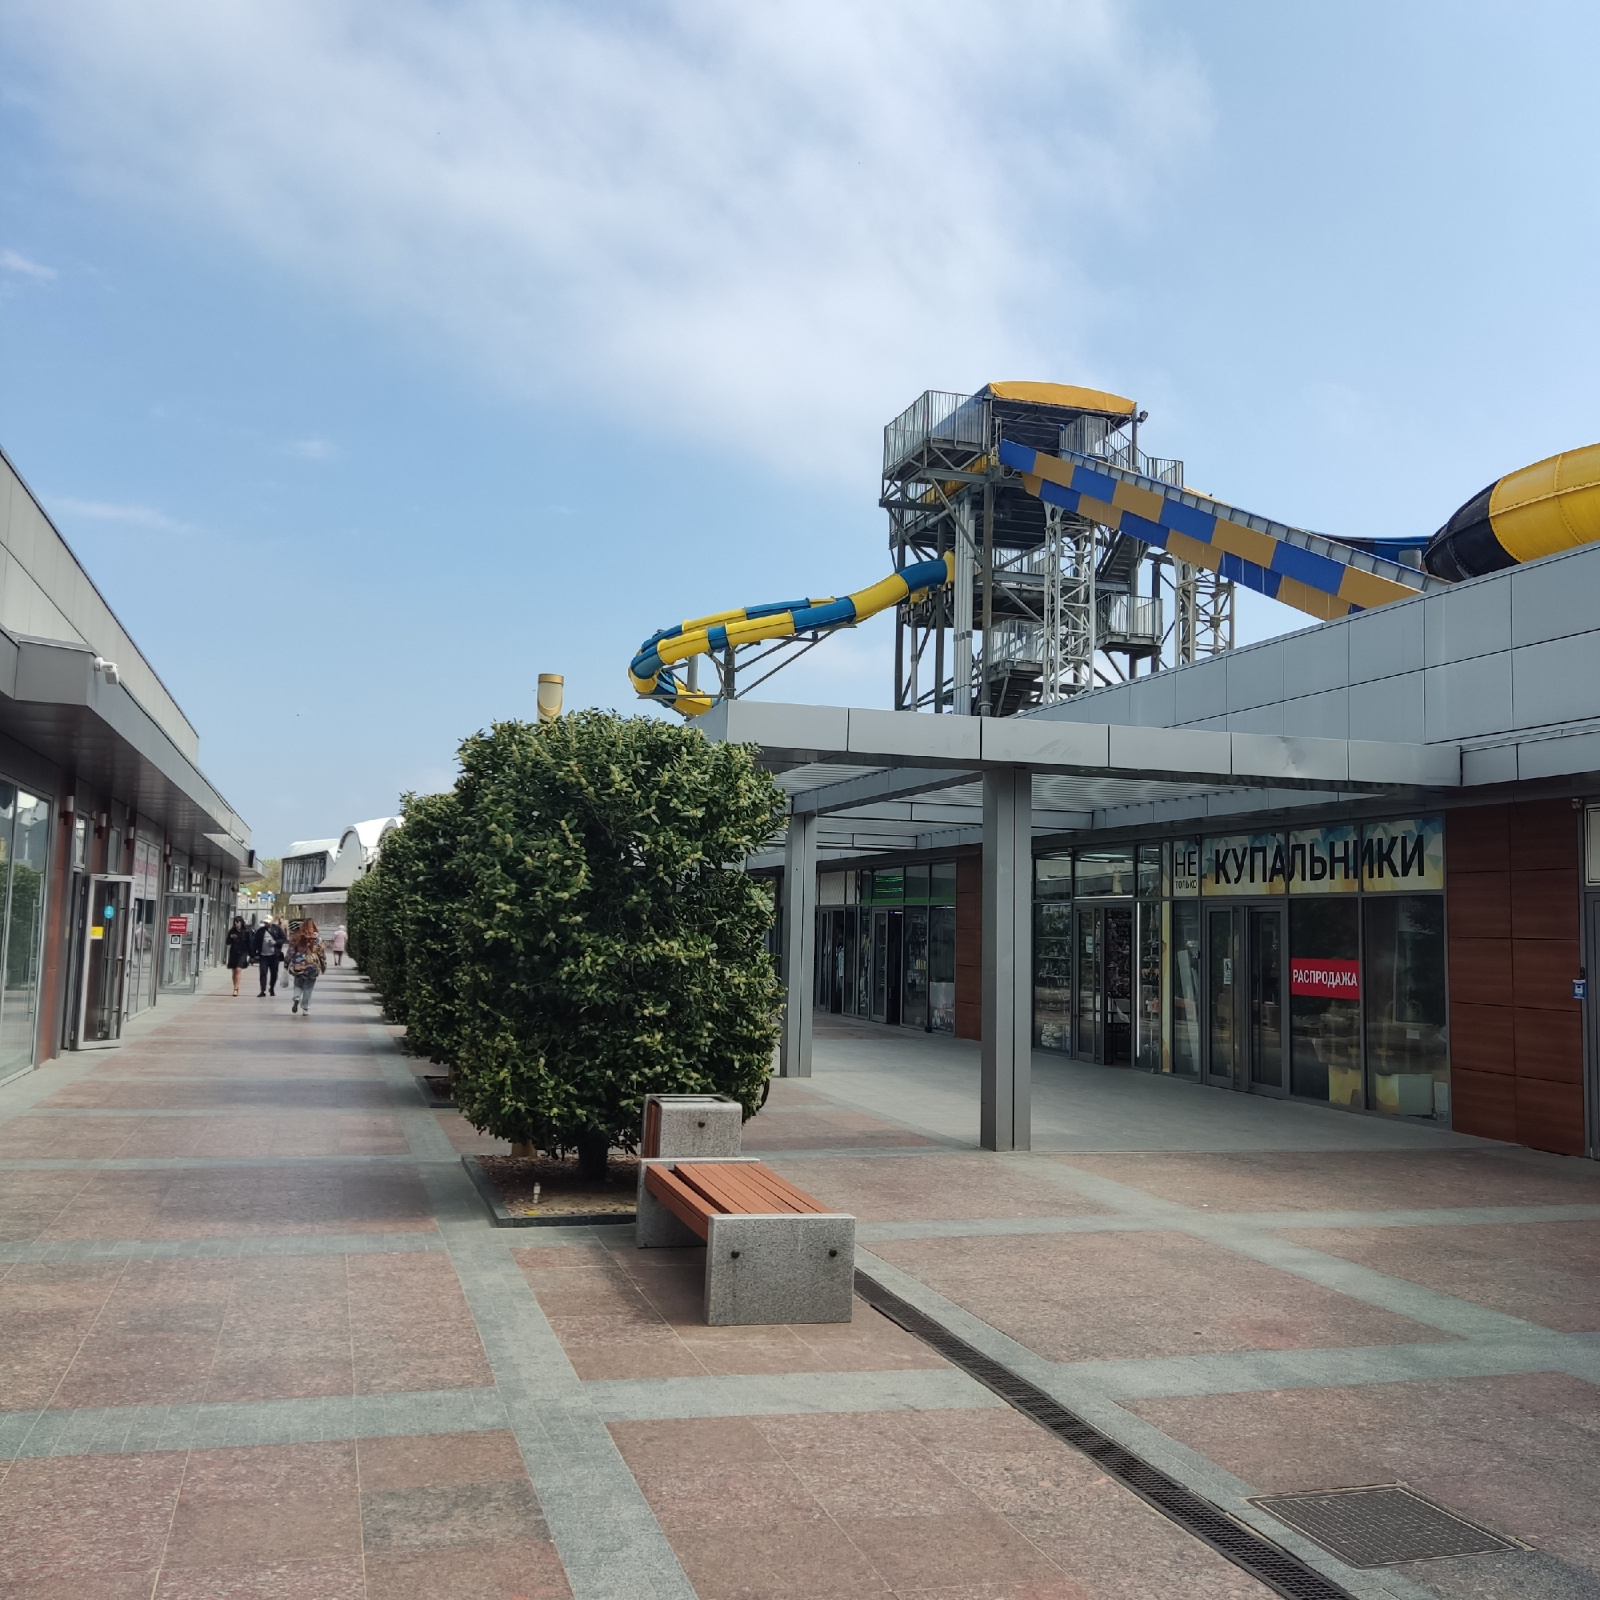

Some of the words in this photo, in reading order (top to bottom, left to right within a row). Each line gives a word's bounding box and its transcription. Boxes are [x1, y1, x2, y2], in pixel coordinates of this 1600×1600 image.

[1175, 851, 1197, 877] НЕ
[1214, 834, 1425, 885] КУПАЛЬНИКИ
[1175, 880, 1197, 889] ТОЛЬКО
[1292, 969, 1358, 988] РАСПРОДАЖА
